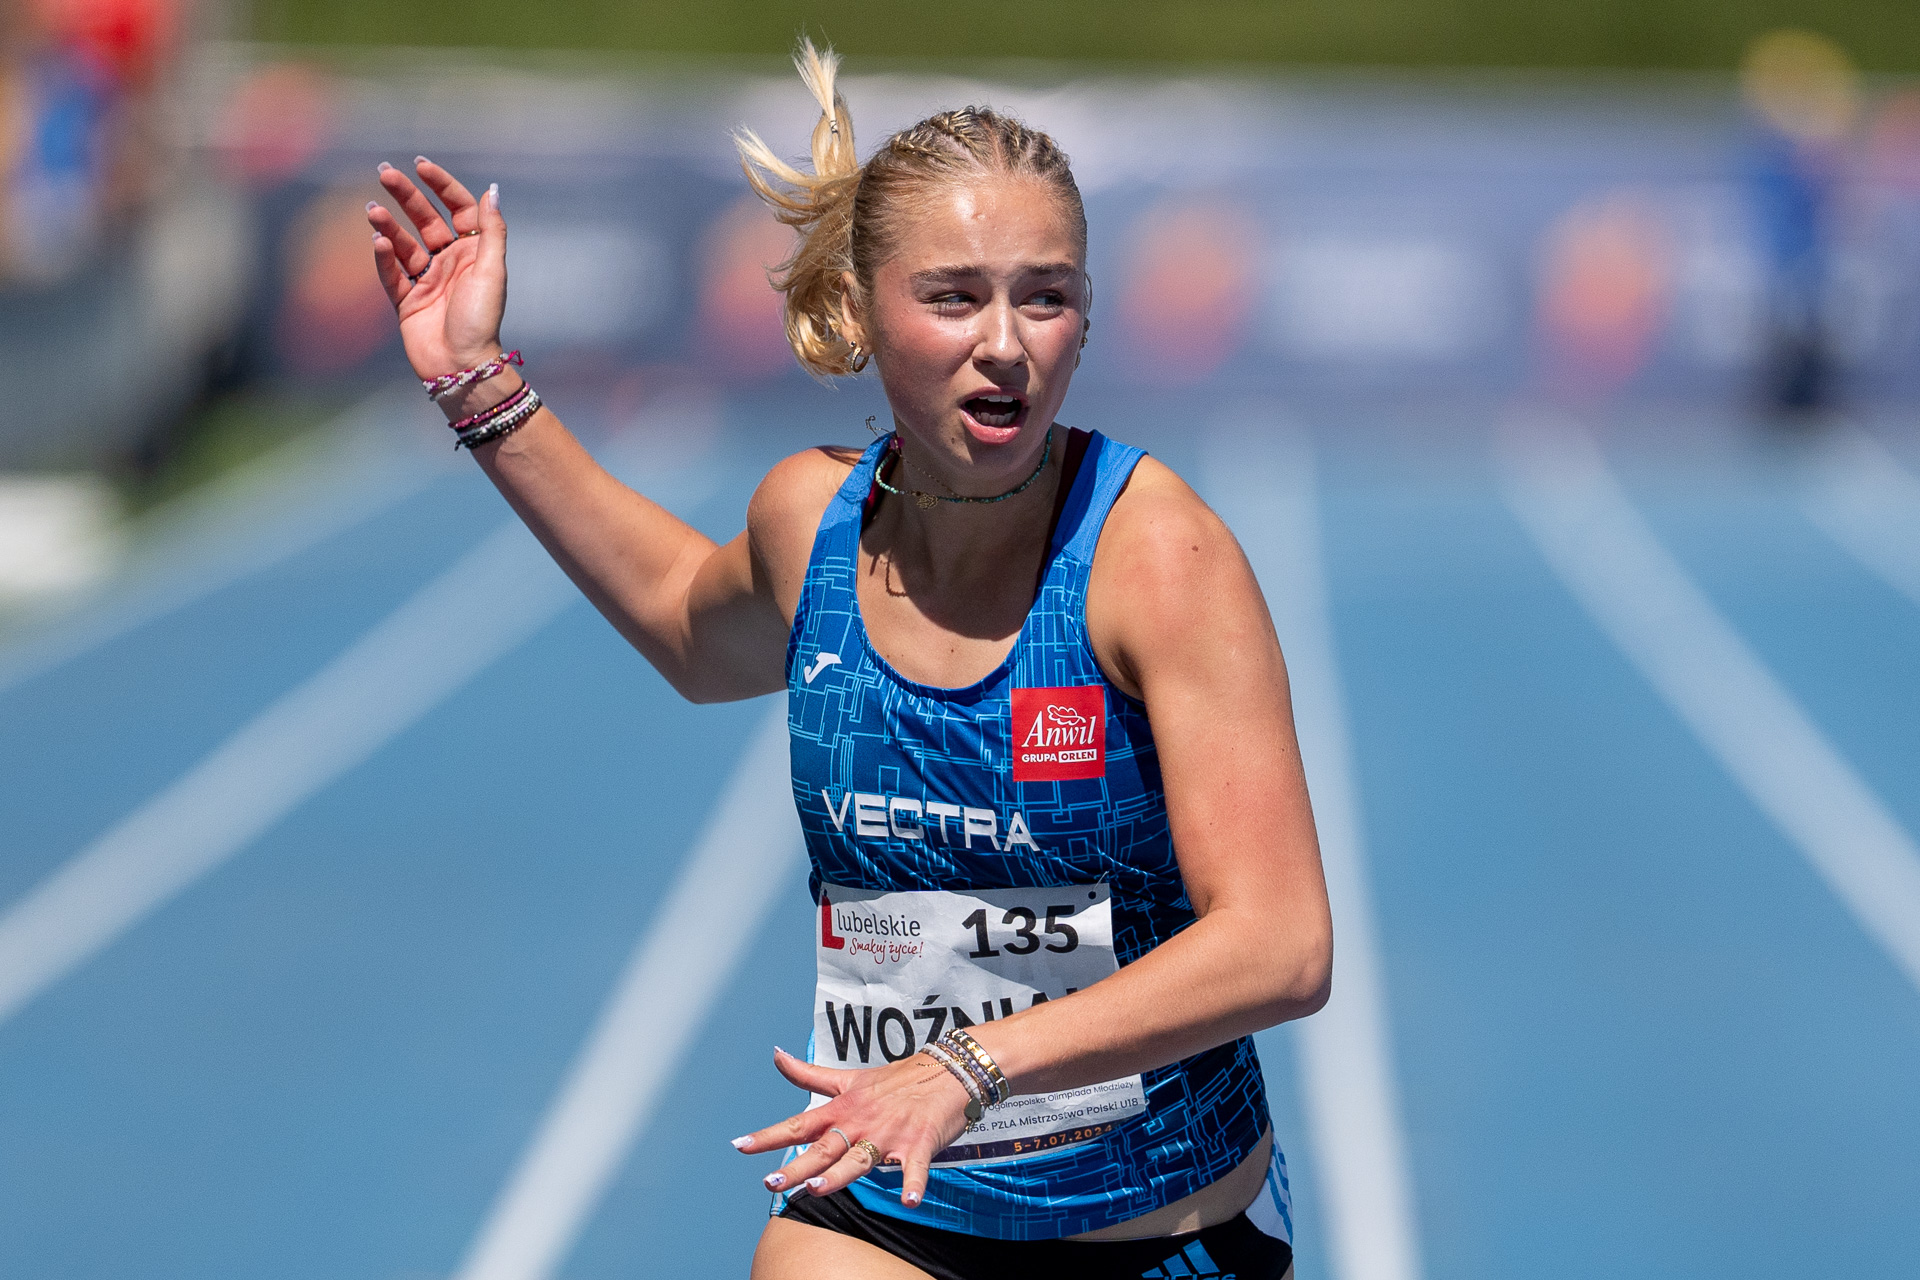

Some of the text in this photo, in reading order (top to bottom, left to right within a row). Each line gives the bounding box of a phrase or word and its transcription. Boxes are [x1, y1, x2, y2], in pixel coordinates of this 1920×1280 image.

[1021, 710, 1097, 748] Anwil
[1021, 750, 1095, 763] GRUPA ORLEN
[821, 789, 1041, 852] VECTRA
[961, 904, 1079, 959] 135
[849, 937, 924, 965] Smakuj życie!
[1047, 1087, 1092, 1102] Olimpiada
[991, 1119, 1017, 1131] PZLA
[1019, 1108, 1084, 1127] Mistrzostwa
[1086, 1101, 1118, 1115] Polski
[1120, 1097, 1139, 1109] U18
